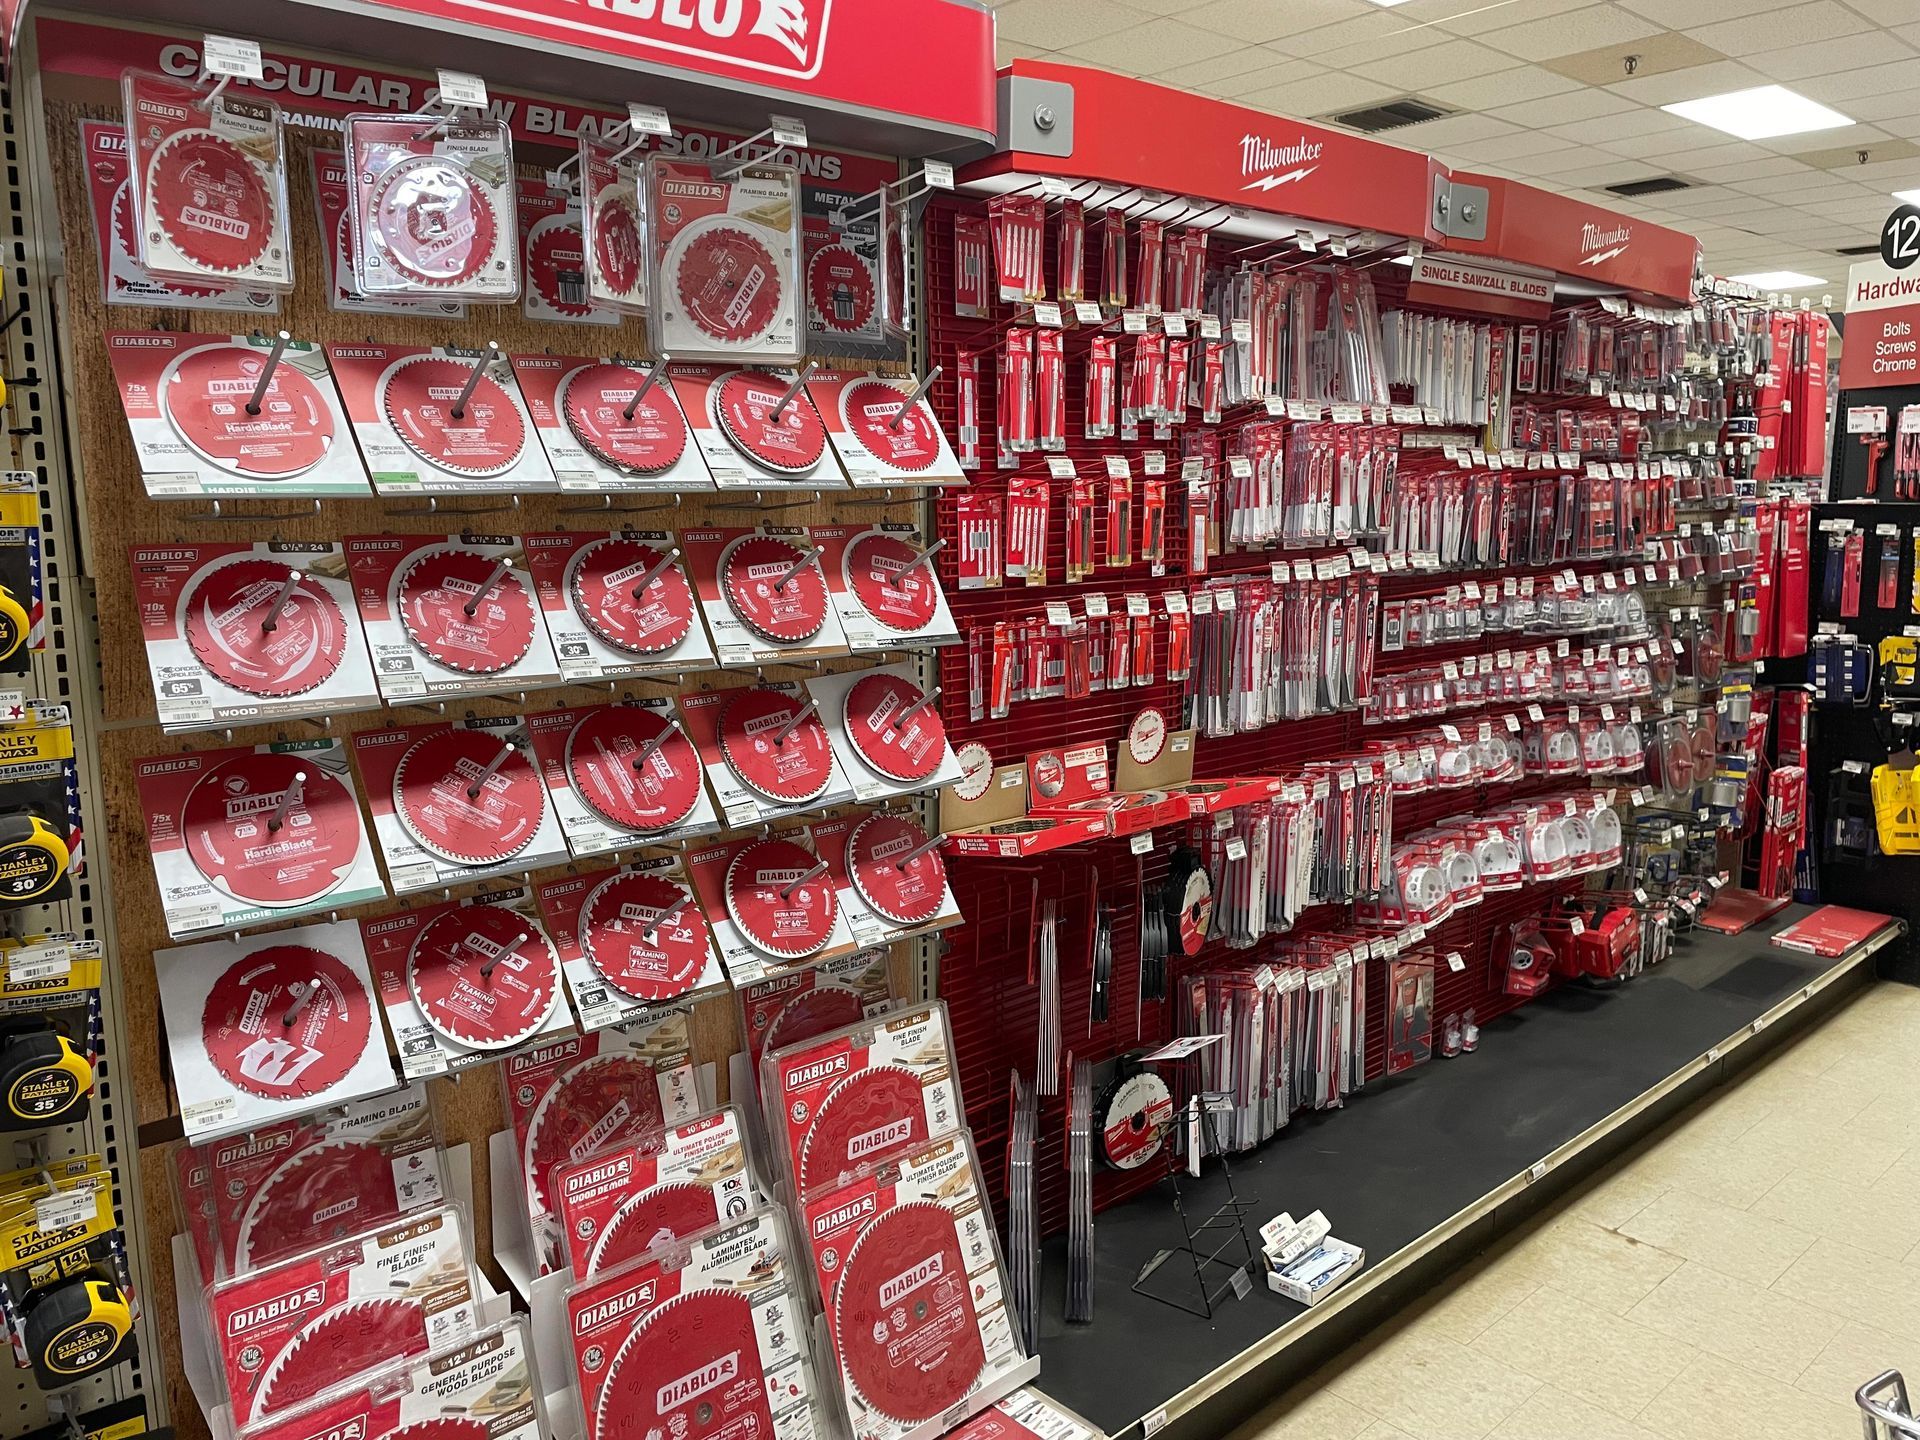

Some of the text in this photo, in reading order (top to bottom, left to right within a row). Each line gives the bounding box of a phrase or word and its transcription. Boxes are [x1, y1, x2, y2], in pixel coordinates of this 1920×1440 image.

[158, 44, 412, 112] CCULAR
[140, 104, 175, 117] DIABLO
[219, 118, 266, 133] FRAMING BLADE
[100, 137, 127, 150] DIA
[1239, 134, 1323, 176] Milwaukee
[666, 184, 709, 196] DIABLO
[768, 190, 788, 198] BLADE
[519, 196, 548, 206] DIABLO
[815, 192, 856, 208] METAL
[208, 214, 248, 238] DIABLO
[1581, 223, 1632, 253] Milwaukee
[1888, 216, 1920, 259] 12
[1421, 265, 1547, 297] SINGLE SAWZALL BLADES
[126, 285, 169, 296] Guarantee
[1857, 277, 1920, 301] Hardwa
[1884, 322, 1910, 337] Bolts
[115, 337, 160, 346] DIABLO
[1876, 340, 1916, 356] Screws
[336, 349, 373, 357] DIABLO
[519, 360, 551, 368] DIABLO
[1873, 358, 1916, 373] Chrome
[128, 384, 147, 392] 75x
[212, 382, 258, 392] DIABLO
[866, 405, 894, 415] DIABLO
[530, 539, 560, 547] DIABLO
[687, 533, 714, 541] DIABLO
[353, 542, 390, 550] DIABLO
[138, 552, 183, 560] DIABLO
[751, 565, 783, 576] DIABLO
[874, 558, 903, 570] DIABLO
[606, 566, 636, 585] DIABLO
[217, 585, 276, 625] DEMO DEMON
[452, 622, 483, 633] FRAMING
[568, 645, 584, 654] 30%
[388, 659, 407, 670] 30%
[603, 666, 631, 674] WOOD
[171, 683, 194, 693] 65%
[429, 683, 462, 691] WOOD
[686, 698, 712, 707] DIABLO
[218, 707, 258, 717] WOOD
[532, 717, 563, 727] DIABLO
[747, 716, 781, 731] DIABLO
[359, 735, 398, 747] DIABLO
[143, 762, 186, 774] DIABLO
[231, 795, 281, 814] DIABLO
[760, 804, 801, 817] ALUMINUM
[816, 825, 840, 835] DIABLO
[874, 843, 903, 858] DIABLO
[956, 838, 968, 850] 10
[693, 852, 720, 864] DIABLO
[439, 869, 471, 879] METAL
[759, 872, 796, 882] DIABLO
[12, 878, 38, 892] 30'
[544, 884, 575, 897] DIABLO
[225, 909, 272, 924] HARDIE
[370, 919, 407, 936] DIABLO
[885, 930, 905, 939] WOOD
[631, 950, 666, 960] FRAMING
[648, 962, 660, 970] 24
[766, 965, 789, 974] WOOD
[829, 958, 871, 974] WOOD BLADE
[457, 982, 495, 1006] FRAMING
[586, 993, 601, 1004] 65%
[241, 1001, 257, 1030] DIABLO
[621, 1007, 648, 1018] WOOD
[652, 1009, 677, 1022] BLADE
[892, 1026, 927, 1042] FINE FINISH
[901, 1034, 921, 1046] BLADE
[411, 1039, 429, 1051] 30%
[451, 1054, 483, 1068] WOOD
[789, 1062, 832, 1086] DIABLO
[21, 1079, 70, 1093] STANLEY
[22, 1086, 69, 1099] FATMAX
[34, 1099, 59, 1111] 35'
[340, 1100, 421, 1130] FRAMING BLADE
[673, 1128, 734, 1156] ULTIMATE POLISHED
[852, 1127, 896, 1154] DIABLO
[221, 1140, 274, 1164] DIABLO
[684, 1138, 726, 1159] FINISH BLADE
[906, 1151, 964, 1184] ULTIMATE POLISHED
[917, 1162, 957, 1185] FINISH BLADE
[569, 1166, 615, 1192] DIABLO
[569, 1177, 631, 1205] WOOD DEMON
[315, 1204, 346, 1220] DIABLO
[816, 1206, 859, 1234] DIABLO
[16, 1225, 87, 1259] FATMAX
[711, 1236, 756, 1260] LAMINATES/
[61, 1249, 87, 1267] 14'
[377, 1241, 436, 1270] FINE FINISH
[701, 1238, 768, 1273] ALUMINUM BLADE
[391, 1255, 425, 1272] BLADE
[883, 1267, 929, 1303] DIABLO
[233, 1298, 299, 1330] DIABLO
[580, 1291, 634, 1329] DIABLO
[57, 1328, 106, 1353] STANLEY
[58, 1335, 108, 1360] FATMAX
[474, 1339, 494, 1355] 44T
[75, 1348, 100, 1366] 40'
[421, 1347, 516, 1395] GENERAL PURPOSE
[437, 1362, 504, 1398] WOOD BLADE
[662, 1368, 717, 1408] DIABLO
[743, 1416, 756, 1428] 96
